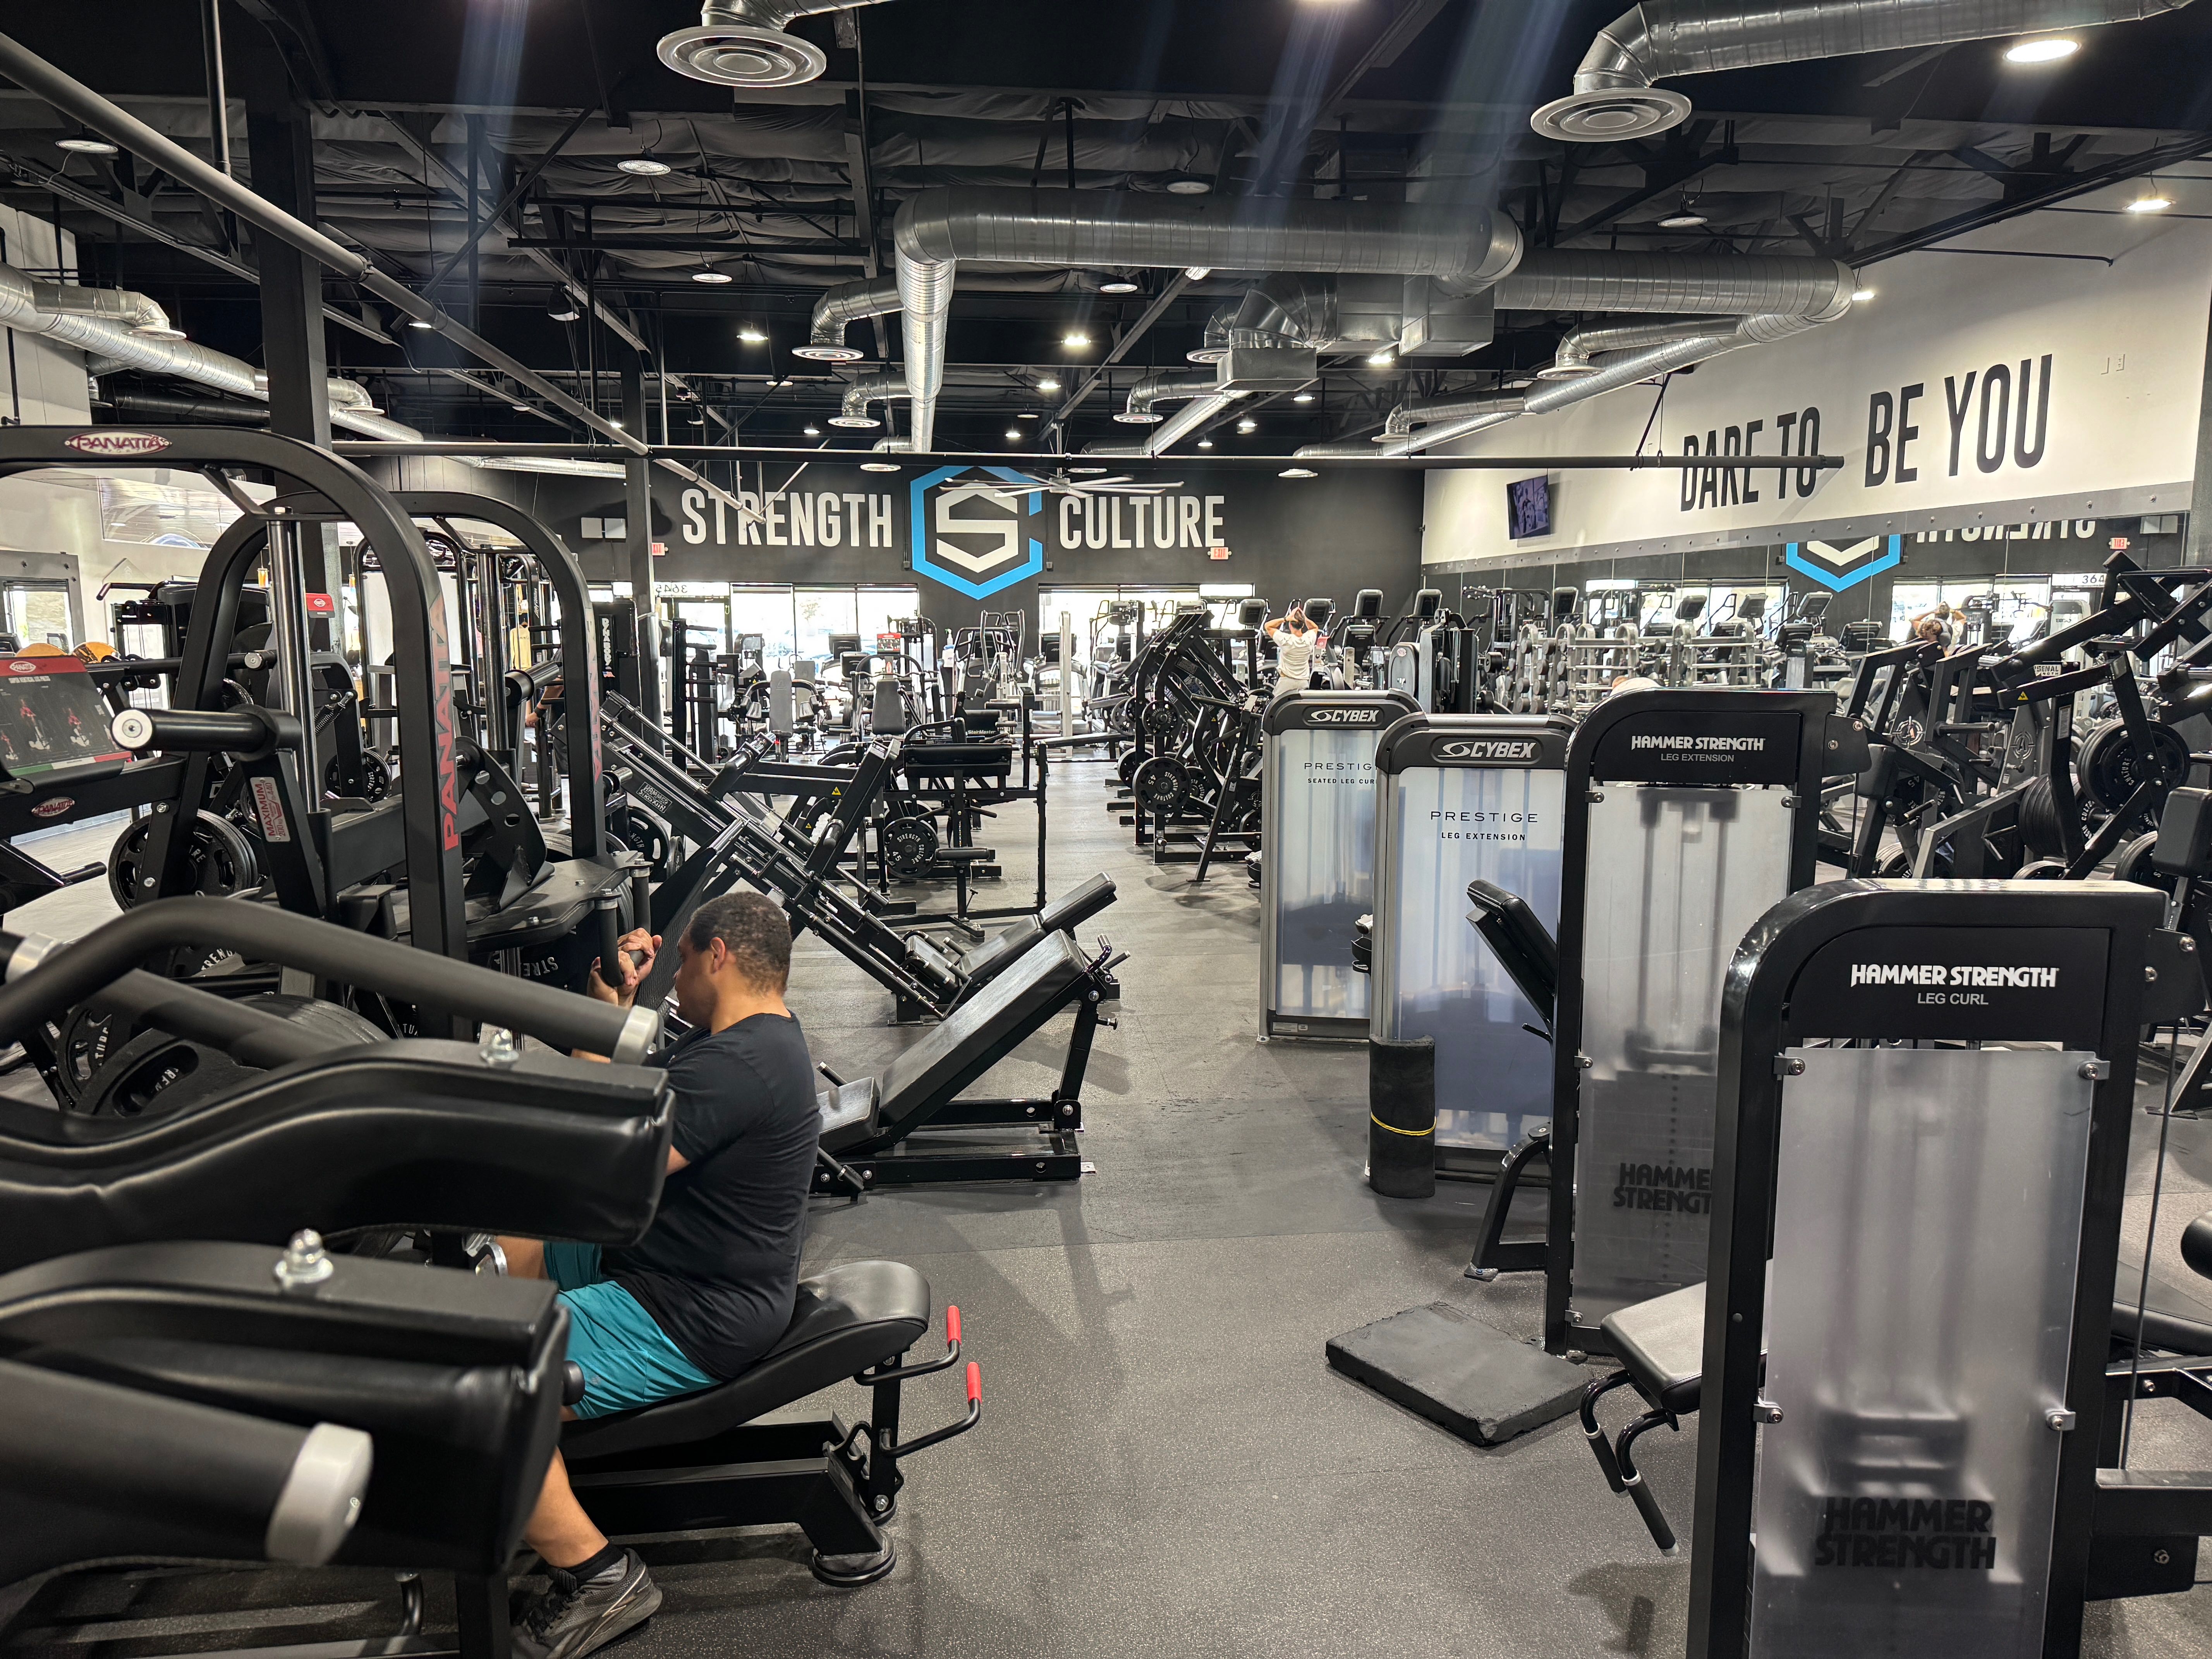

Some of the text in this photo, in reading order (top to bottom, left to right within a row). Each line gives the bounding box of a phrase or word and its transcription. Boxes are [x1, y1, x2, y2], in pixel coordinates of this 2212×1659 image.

[1681, 354, 2052, 512] DARE TO BE YOU
[79, 438, 160, 449] PANATTA
[682, 489, 1224, 549] STRENGTH CULTURE
[653, 544, 661, 553] XIT
[1214, 548, 1226, 558] EXIT
[2082, 575, 2104, 584] 364
[602, 618, 612, 666] DYNABODY
[430, 591, 459, 851] PANATTA
[1331, 710, 1379, 722] CYBEX
[1470, 742, 1536, 758] CYBEX
[1632, 736, 1763, 750] HAMMER STRENGTH
[1682, 754, 1734, 762] EXTENSION
[1148, 775, 1156, 785] 45
[1153, 772, 1178, 801] STRENGTH CULTURE
[265, 783, 274, 795] 440
[643, 785, 668, 805] HAMMER
[39, 800, 72, 812] PANATTA
[255, 783, 276, 836] MAXIMUM
[1431, 812, 1538, 823] PRESTIGE
[276, 824, 286, 837] 200
[897, 833, 924, 864] STRENGTH CULTURE
[893, 852, 902, 861] 45
[1851, 964, 2056, 987] HAMMER STRENGTH
[1918, 993, 1989, 1005] LEG CURL
[1619, 1163, 1713, 1192] HAMME
[1613, 1187, 1712, 1214] STRENGT
[1824, 1497, 1992, 1535] HAMMER
[1815, 1533, 1997, 1570] STRENGTH
